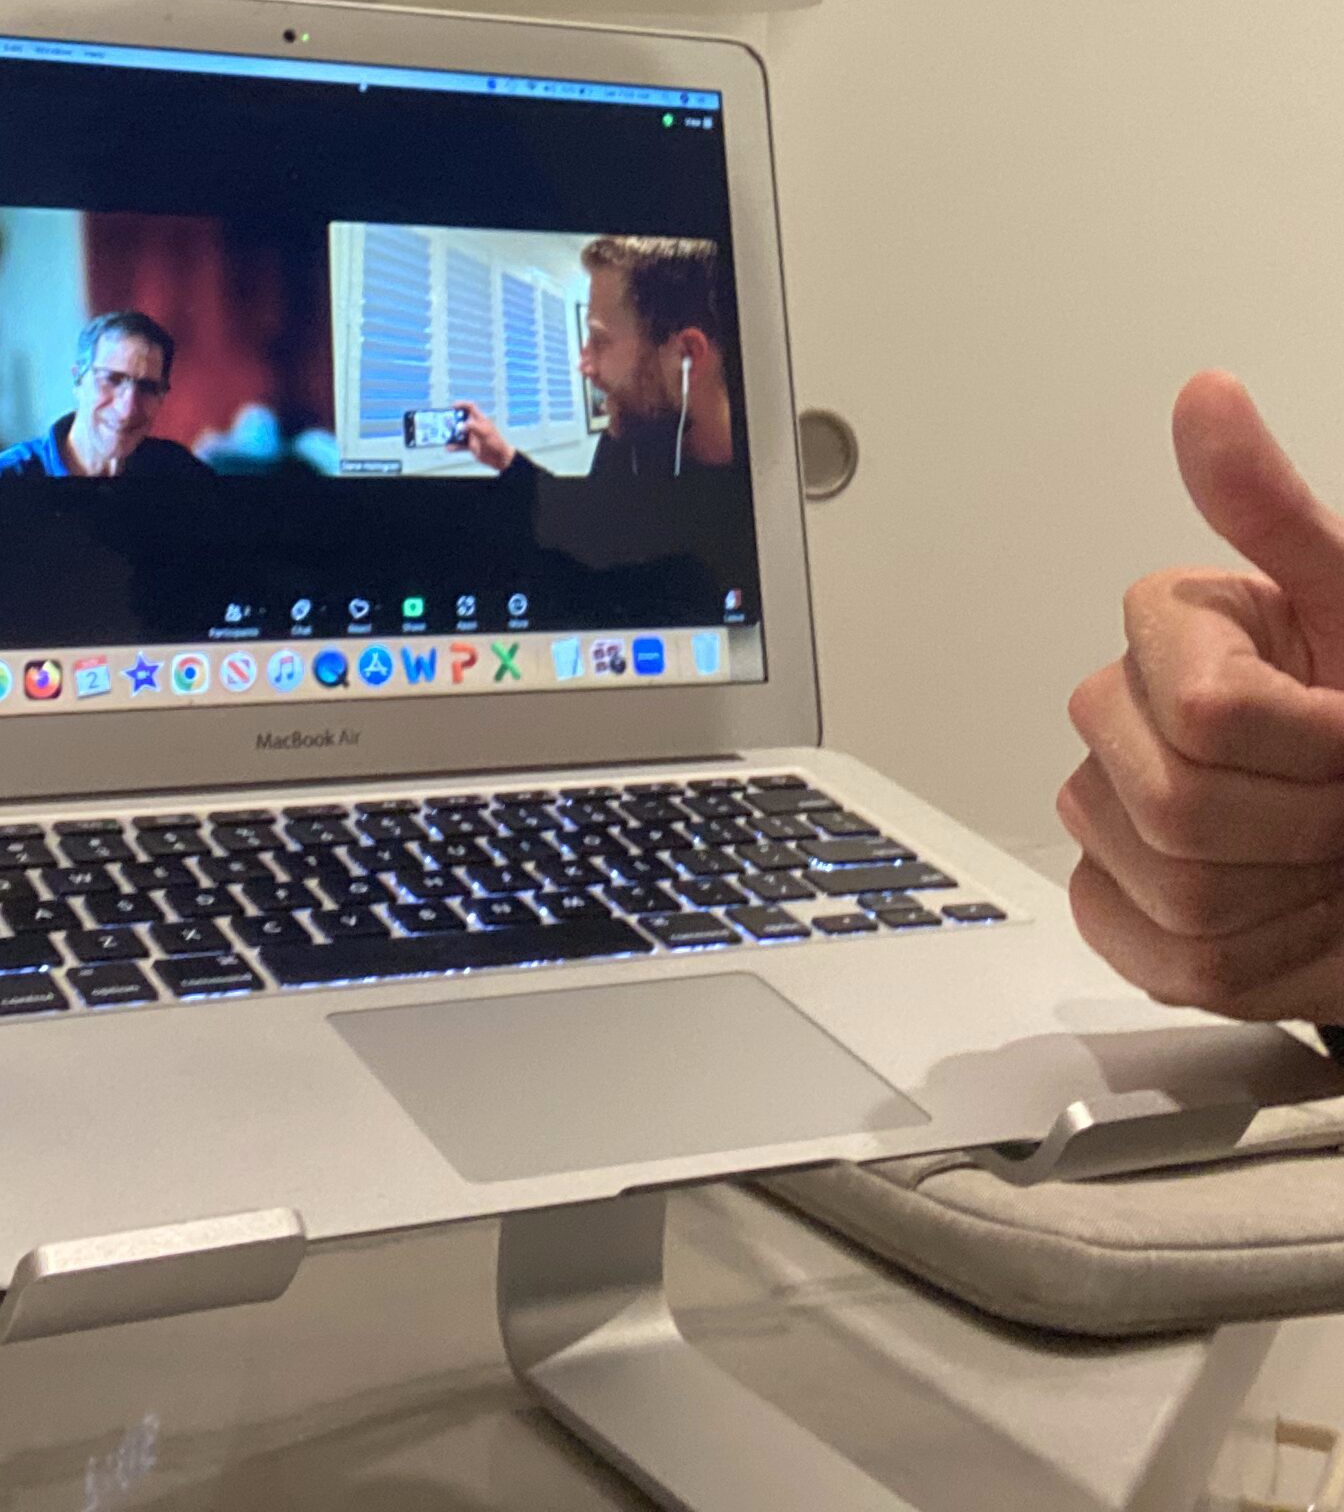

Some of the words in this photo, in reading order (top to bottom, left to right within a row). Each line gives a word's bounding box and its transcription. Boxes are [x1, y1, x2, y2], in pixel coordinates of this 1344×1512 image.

[86, 671, 101, 689] 2
[400, 646, 437, 685] W
[449, 642, 478, 685] P
[490, 641, 522, 682] X
[256, 729, 335, 750] MacBook
